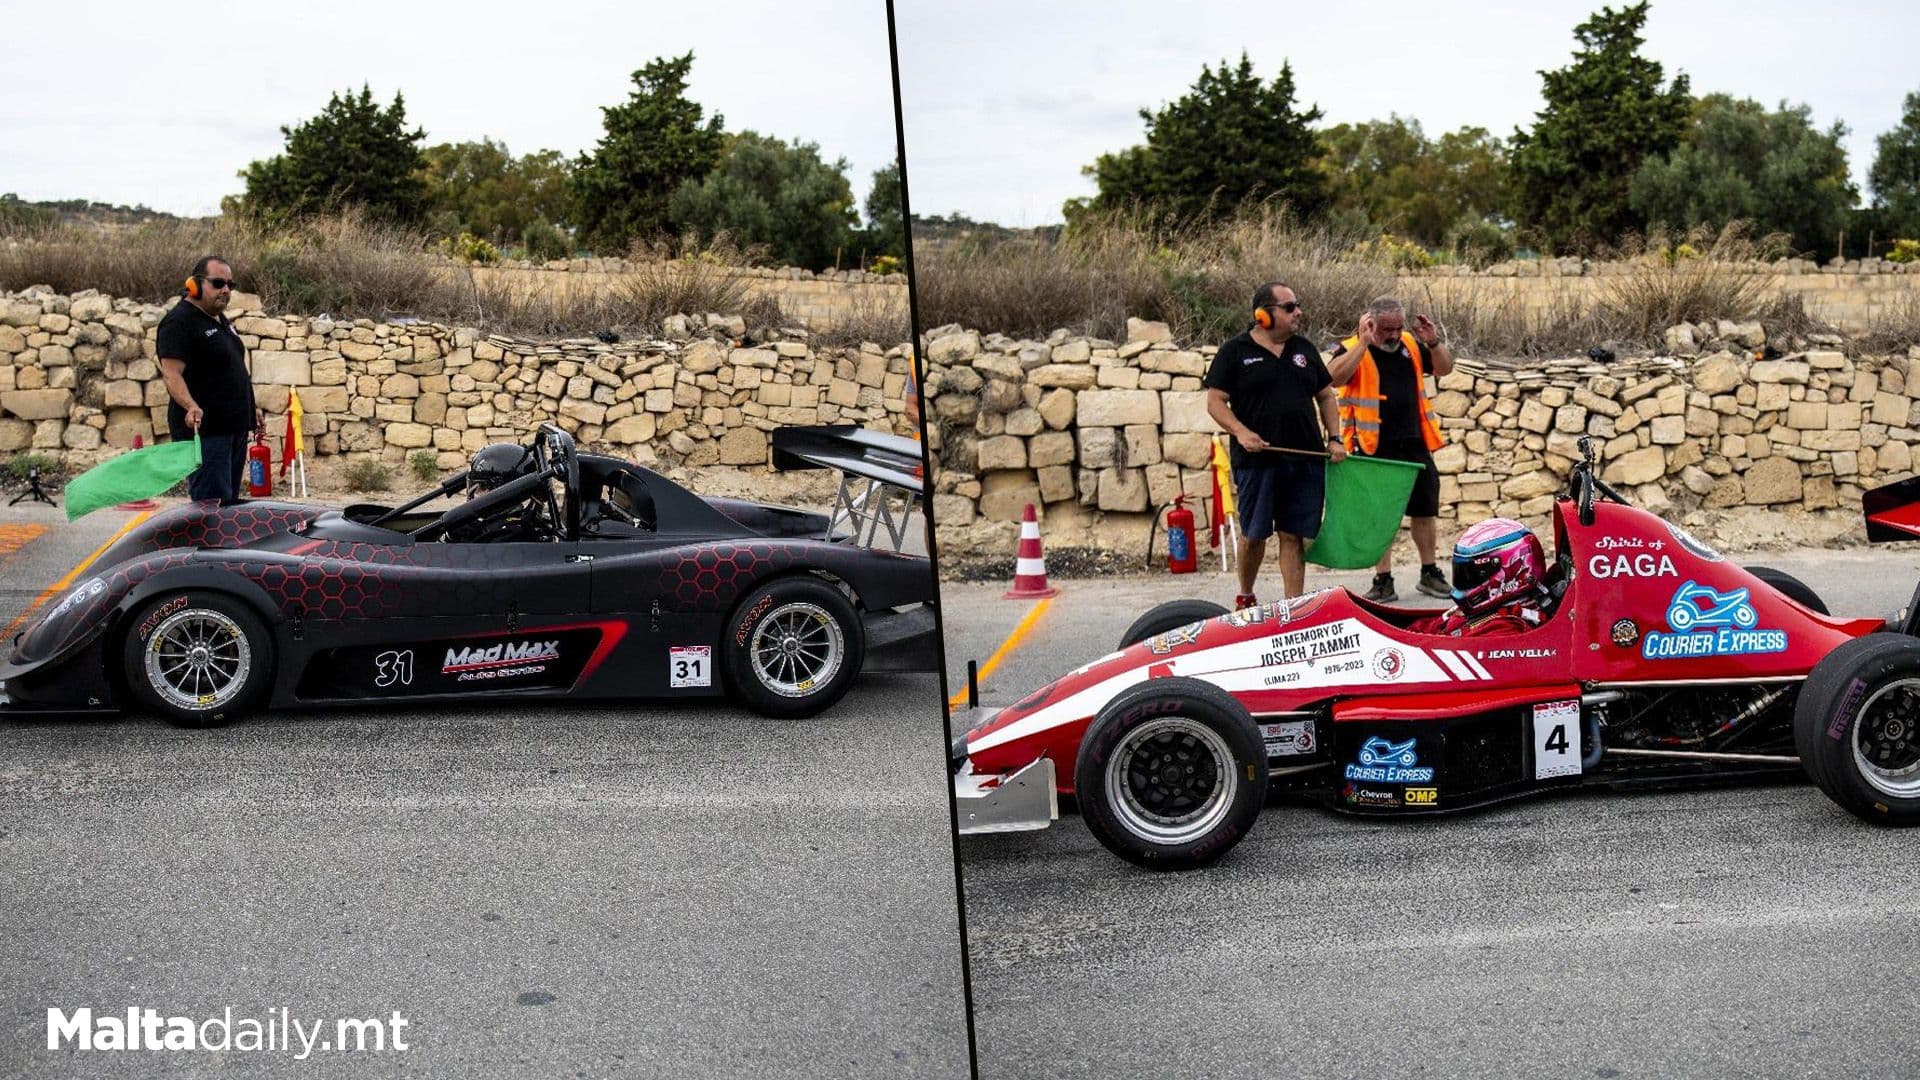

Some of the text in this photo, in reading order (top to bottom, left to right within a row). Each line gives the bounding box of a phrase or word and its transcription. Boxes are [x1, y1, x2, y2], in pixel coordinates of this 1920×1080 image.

[1595, 536, 1666, 550] Spirit of
[1589, 553, 1679, 579] GAGA
[138, 595, 189, 641] AVON
[1271, 622, 1345, 649] IN MEMORY OF
[1645, 630, 1785, 657] COURIER EXPRESS
[443, 640, 560, 667] Mad Max
[1260, 633, 1361, 668] JOSEPH ZAMMIT
[1488, 648, 1551, 659] JEAN VELLA
[375, 649, 413, 687] 31
[676, 659, 701, 680] 31
[1545, 724, 1570, 755] 4
[1346, 764, 1433, 782] COURIER EXPRESS
[1360, 789, 1393, 799] Chevron
[1405, 790, 1438, 803] OMP
